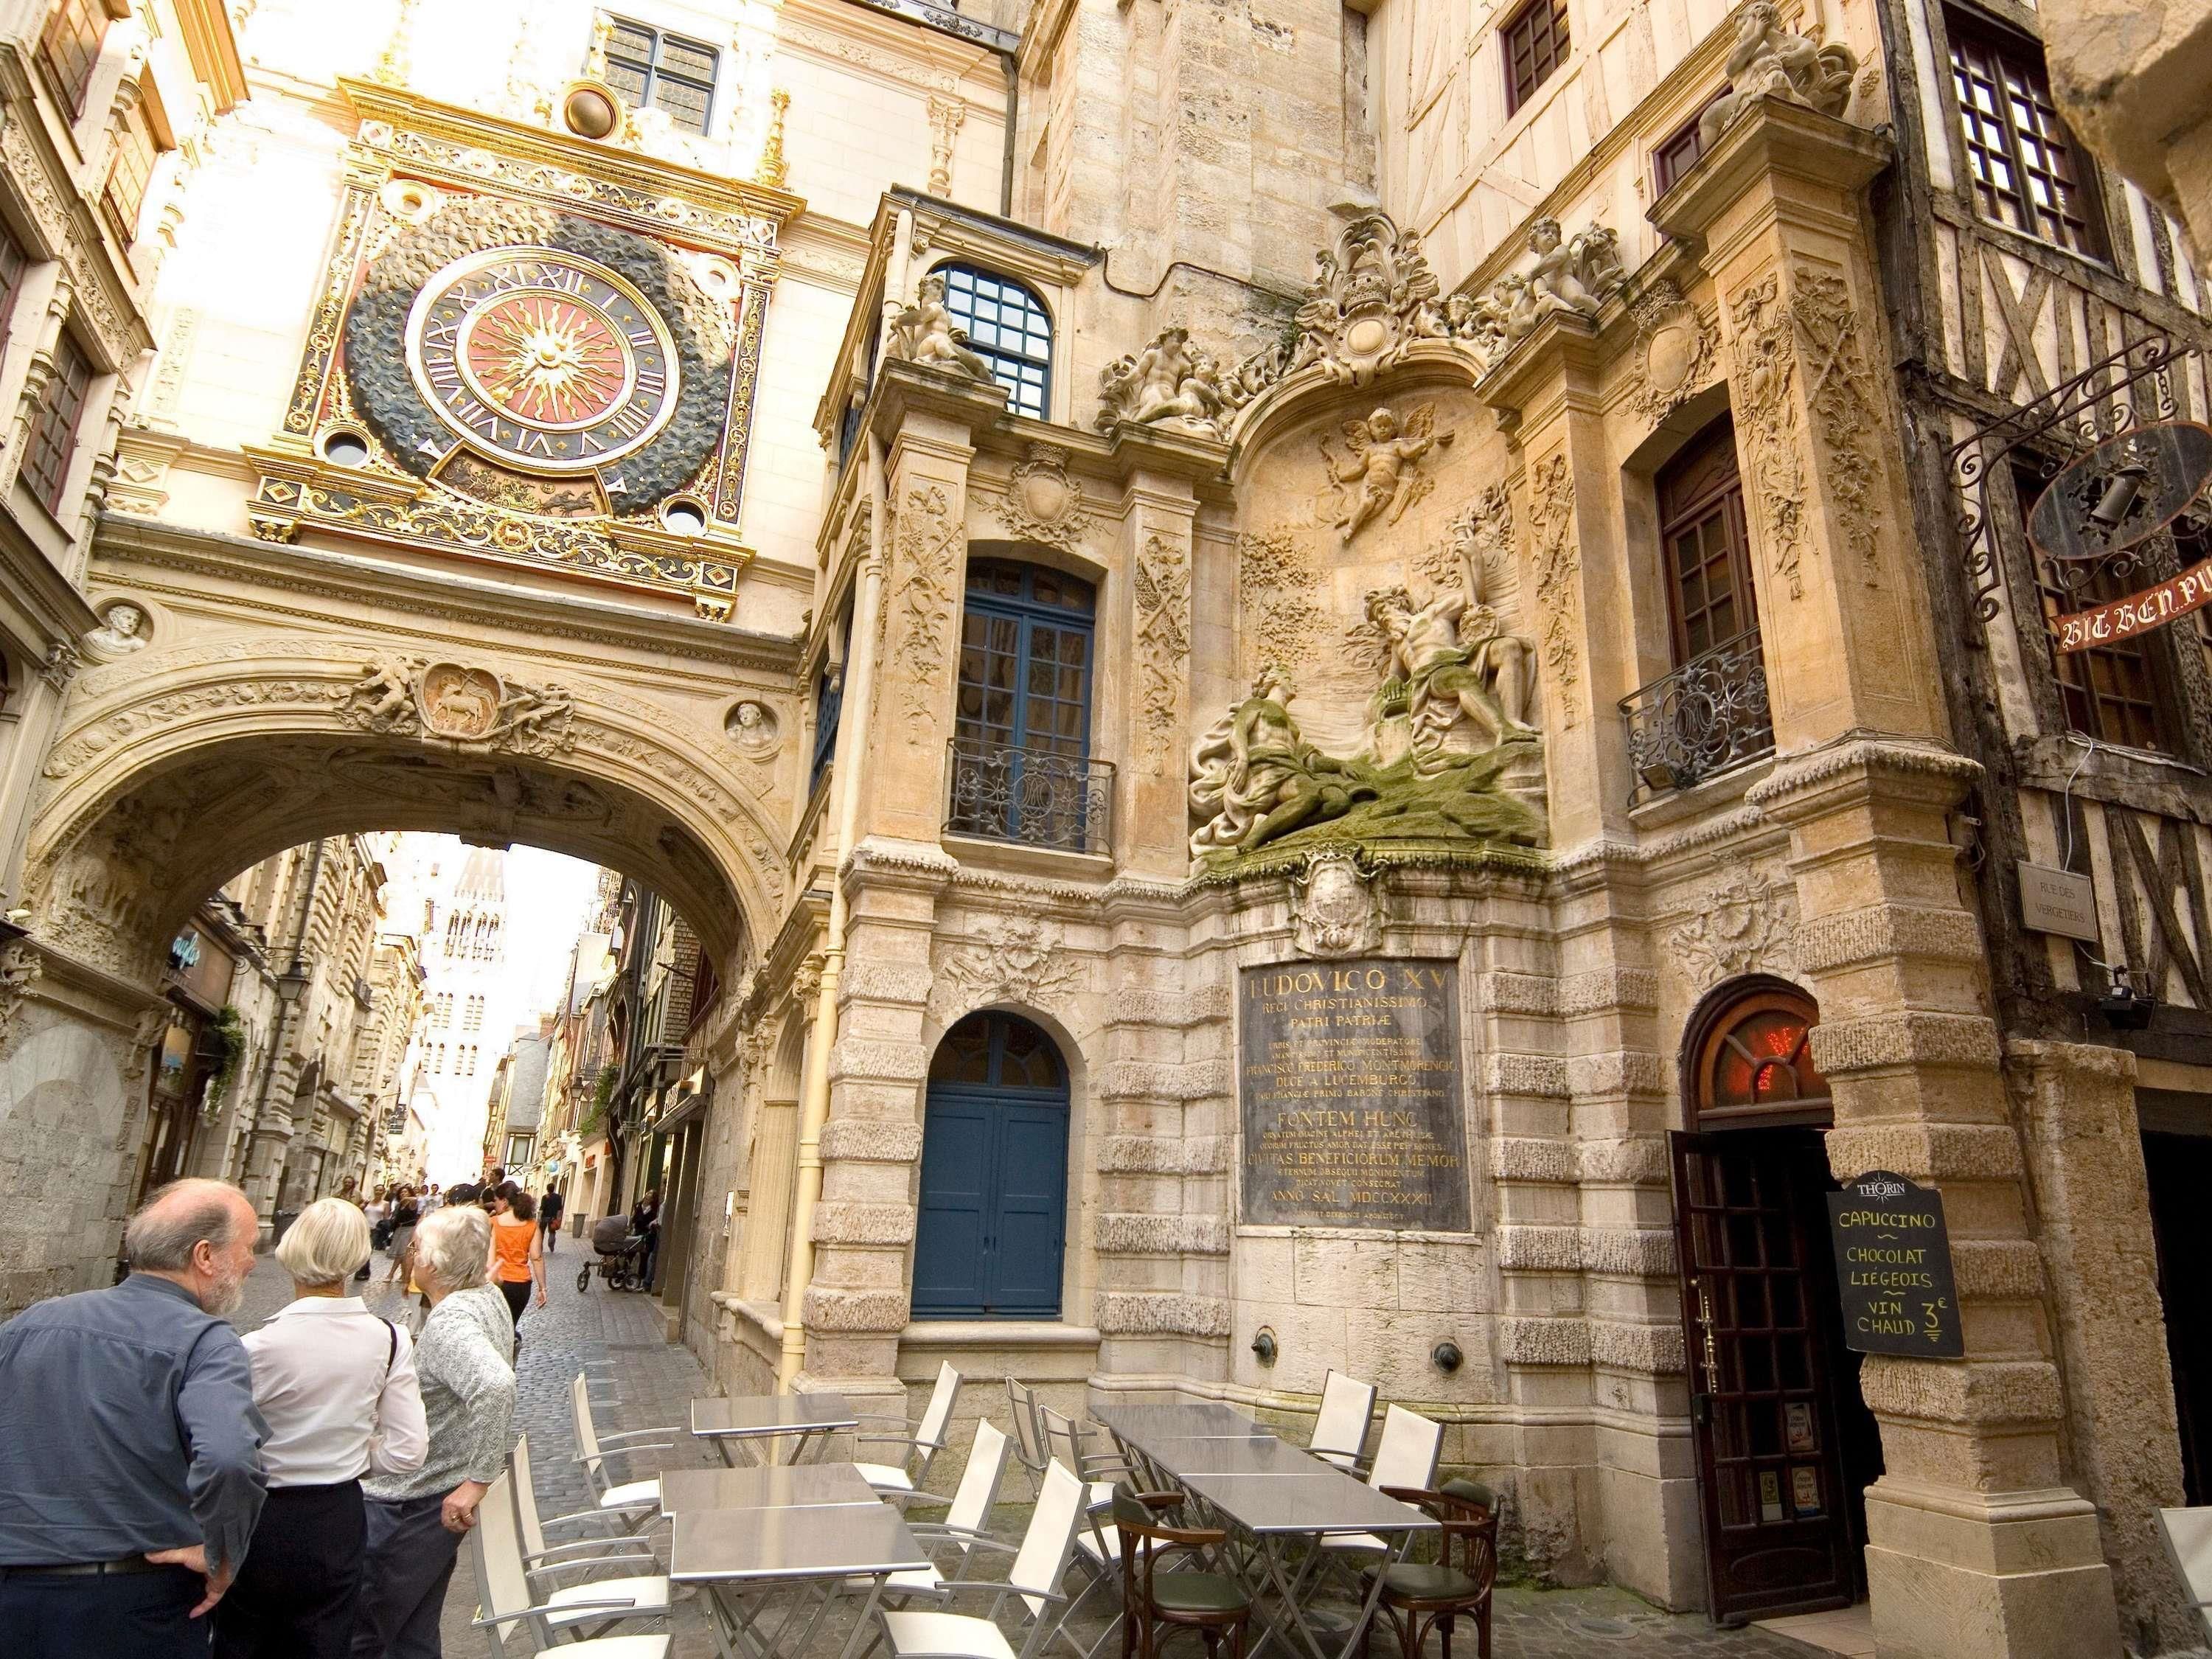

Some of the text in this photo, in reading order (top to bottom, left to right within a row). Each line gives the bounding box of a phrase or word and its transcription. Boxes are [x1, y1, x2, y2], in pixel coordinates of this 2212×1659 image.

[487, 264, 527, 291] XI
[538, 263, 585, 293] XII
[444, 284, 479, 310] X
[424, 318, 459, 350] IX
[627, 329, 657, 349] II
[636, 369, 665, 397] III
[453, 400, 499, 442] VII
[514, 428, 555, 458] VI
[577, 430, 607, 459] V
[2062, 610, 2112, 650] BIG
[2113, 588, 2180, 633] BEN
[2040, 882, 2076, 899] RUE DES
[2036, 902, 2086, 923] VERGETIERS
[1251, 968, 1449, 999] LUDOVICO XV
[1293, 997, 1428, 1012] CHRISTIANISSIMO
[1290, 1016, 1330, 1029] PATRI
[1276, 1077, 1304, 1087] DUCE
[1277, 1110, 1418, 1128] FONTEM HUNC
[1367, 1130, 1380, 1138] ET
[1298, 1151, 1399, 1166] BENEFICIORUM
[1402, 1153, 1460, 1168] MEMOR
[1857, 1182, 1905, 1195] THORIN
[1838, 1211, 1935, 1228] CAPUCCINO
[1846, 1247, 1927, 1264] CHOCOLAT
[1868, 1301, 1902, 1315] VIN
[1857, 1316, 1916, 1335] CHAUD
